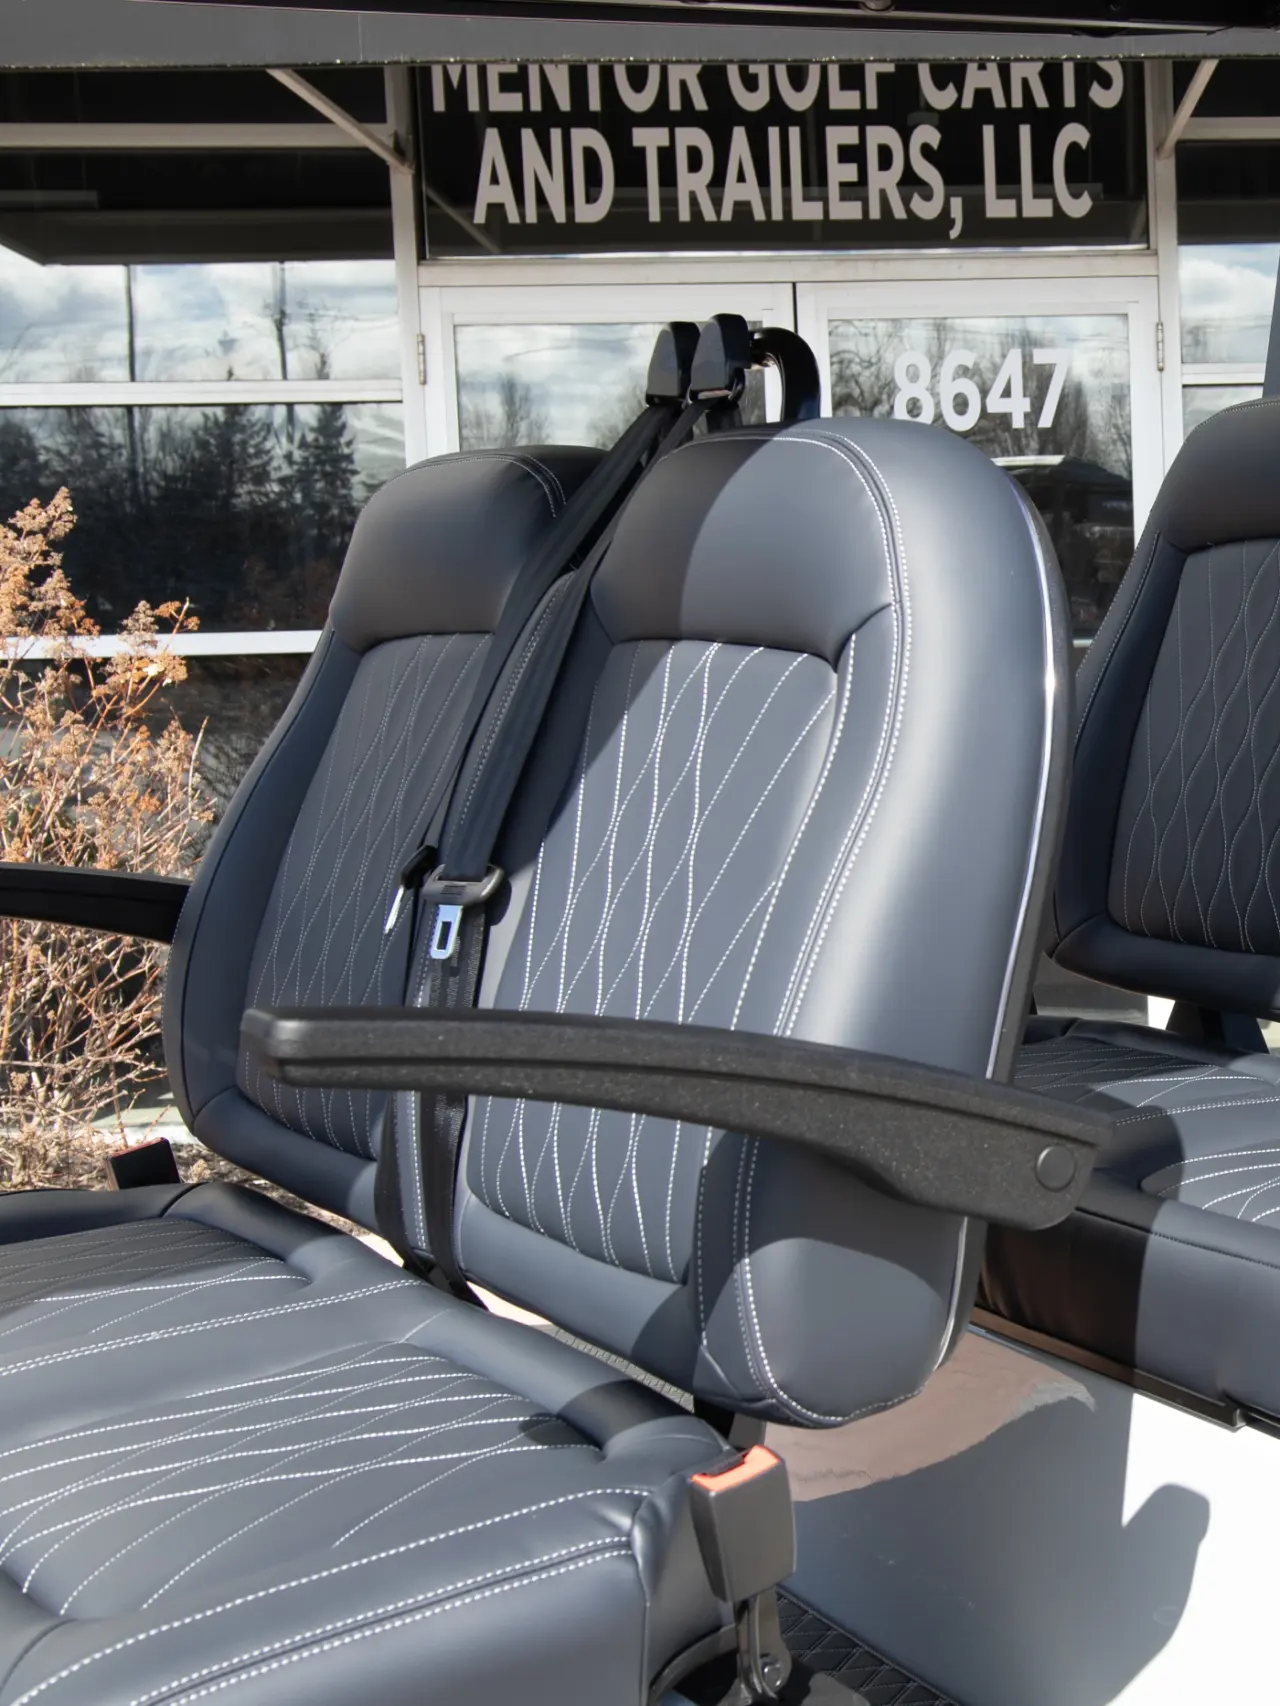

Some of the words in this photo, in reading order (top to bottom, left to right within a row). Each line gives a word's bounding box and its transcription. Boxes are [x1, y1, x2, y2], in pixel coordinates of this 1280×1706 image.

[473, 127, 615, 224] AND
[632, 122, 963, 240] TRAILERS,
[982, 121, 1093, 218] LLC
[894, 348, 1073, 432] 8647
